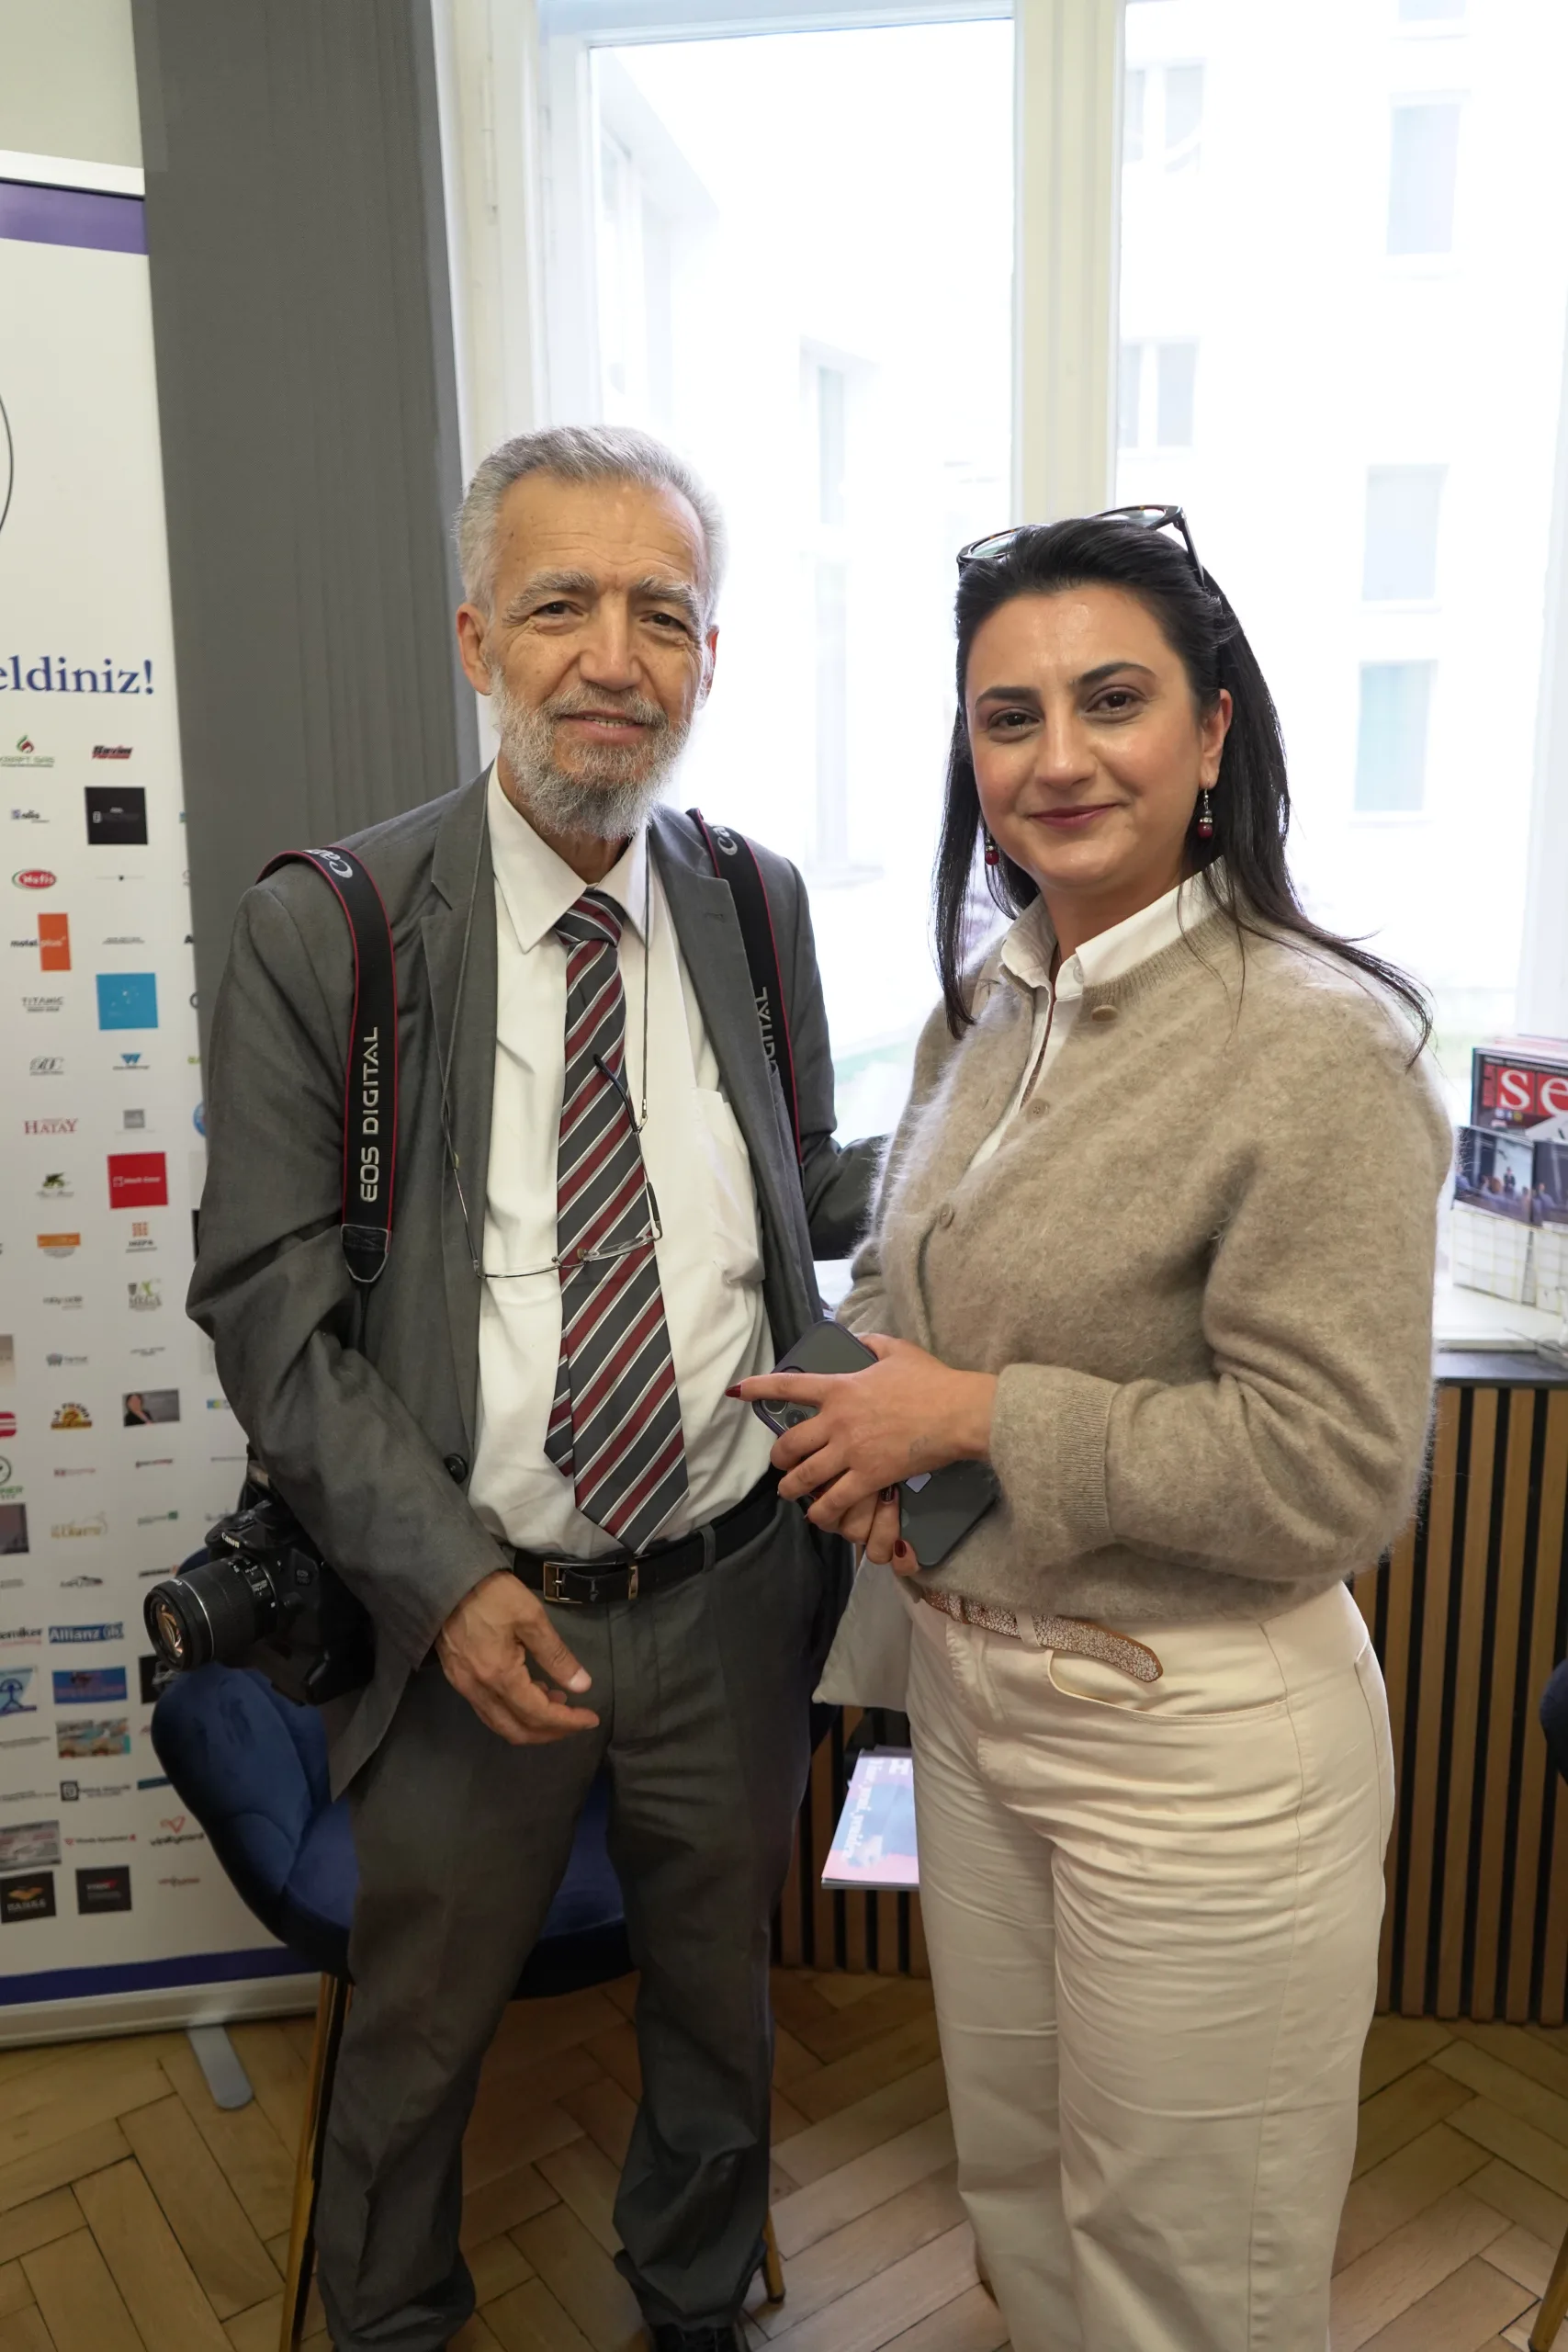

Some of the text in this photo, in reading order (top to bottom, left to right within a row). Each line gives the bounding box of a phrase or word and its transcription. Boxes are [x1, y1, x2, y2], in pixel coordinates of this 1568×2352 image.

[359, 1026, 379, 1203] EOS DIGITAL
[24, 1118, 79, 1135] HATAY
[221, 1532, 241, 1549] Canon
[50, 1627, 100, 1643] Allianz
